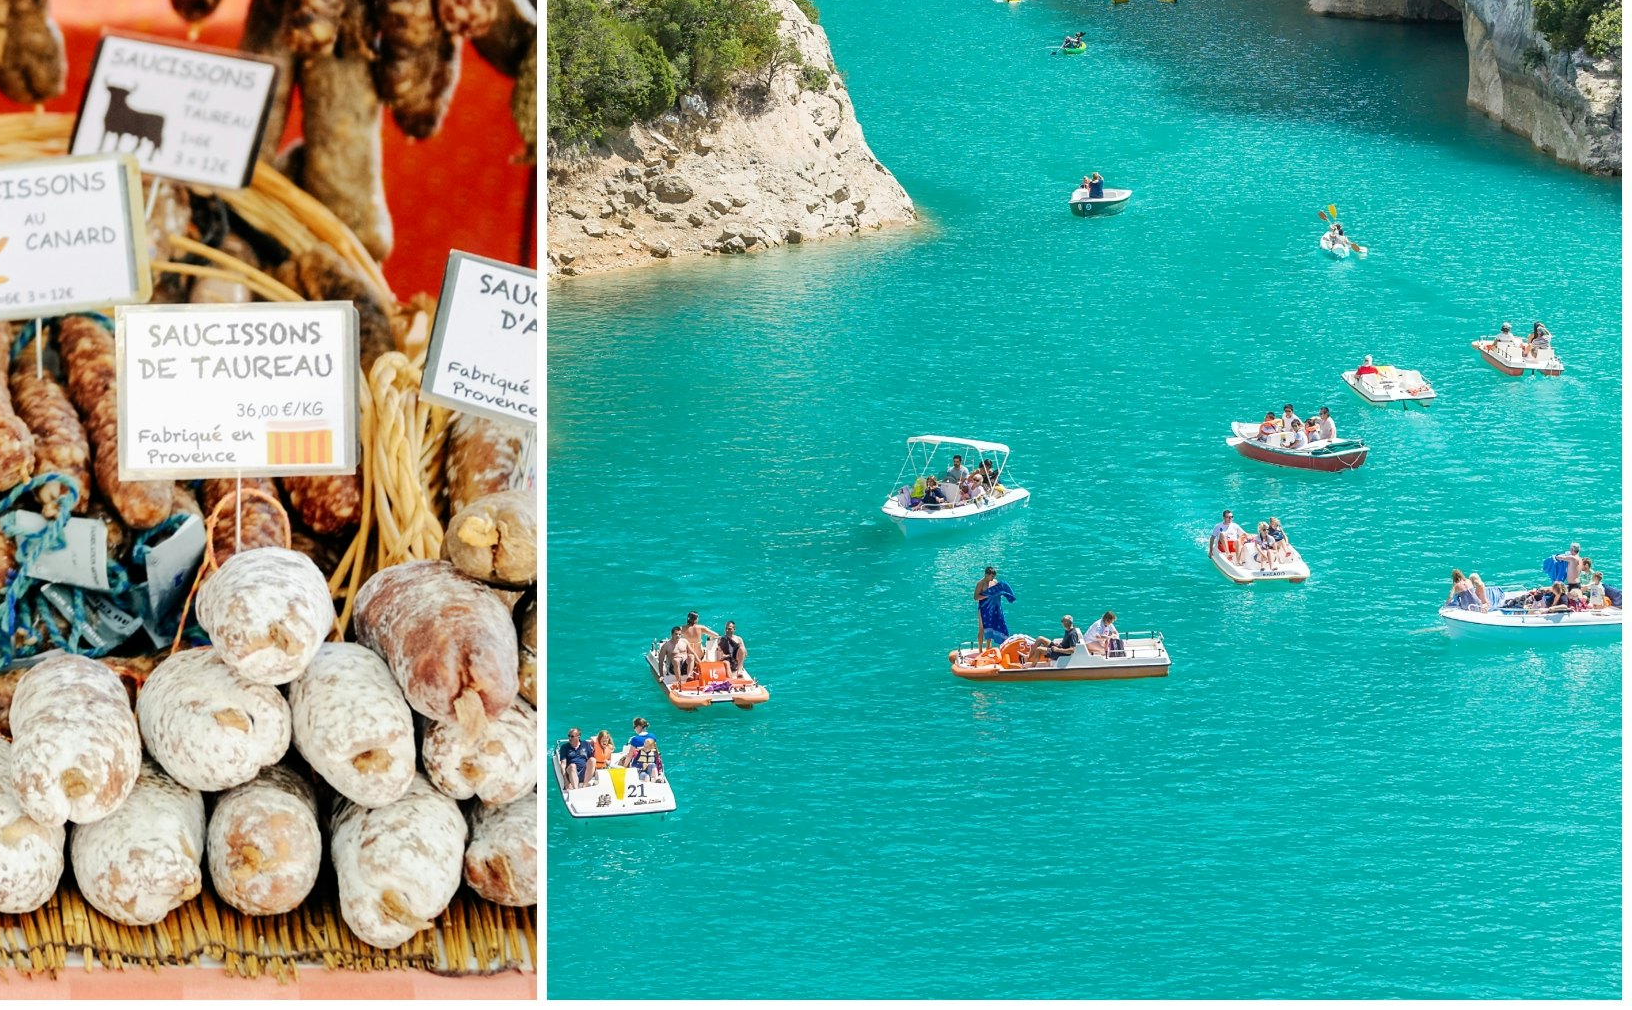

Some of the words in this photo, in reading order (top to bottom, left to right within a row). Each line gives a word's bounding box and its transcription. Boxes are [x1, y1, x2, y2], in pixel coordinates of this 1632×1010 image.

[110, 48, 256, 89] SAUCISSONS
[186, 88, 209, 102] AU
[183, 105, 253, 130] TAUREAU
[173, 151, 182, 165] 3
[203, 156, 229, 174] 12€
[24, 212, 46, 226] AU
[25, 226, 116, 251] CANARD
[28, 291, 35, 302] 3
[51, 287, 74, 301] 12€
[148, 321, 323, 348] SAUCISSONS
[138, 357, 176, 380] DE
[191, 354, 333, 380] TAUREAU
[447, 361, 530, 395] Fabriqué
[236, 402, 278, 420] 36,00
[453, 381, 537, 417] Provence
[138, 424, 223, 450] Fabriqué
[232, 429, 254, 442] en
[147, 449, 236, 464] Provence
[709, 669, 719, 679] 16
[627, 784, 648, 798] 21
